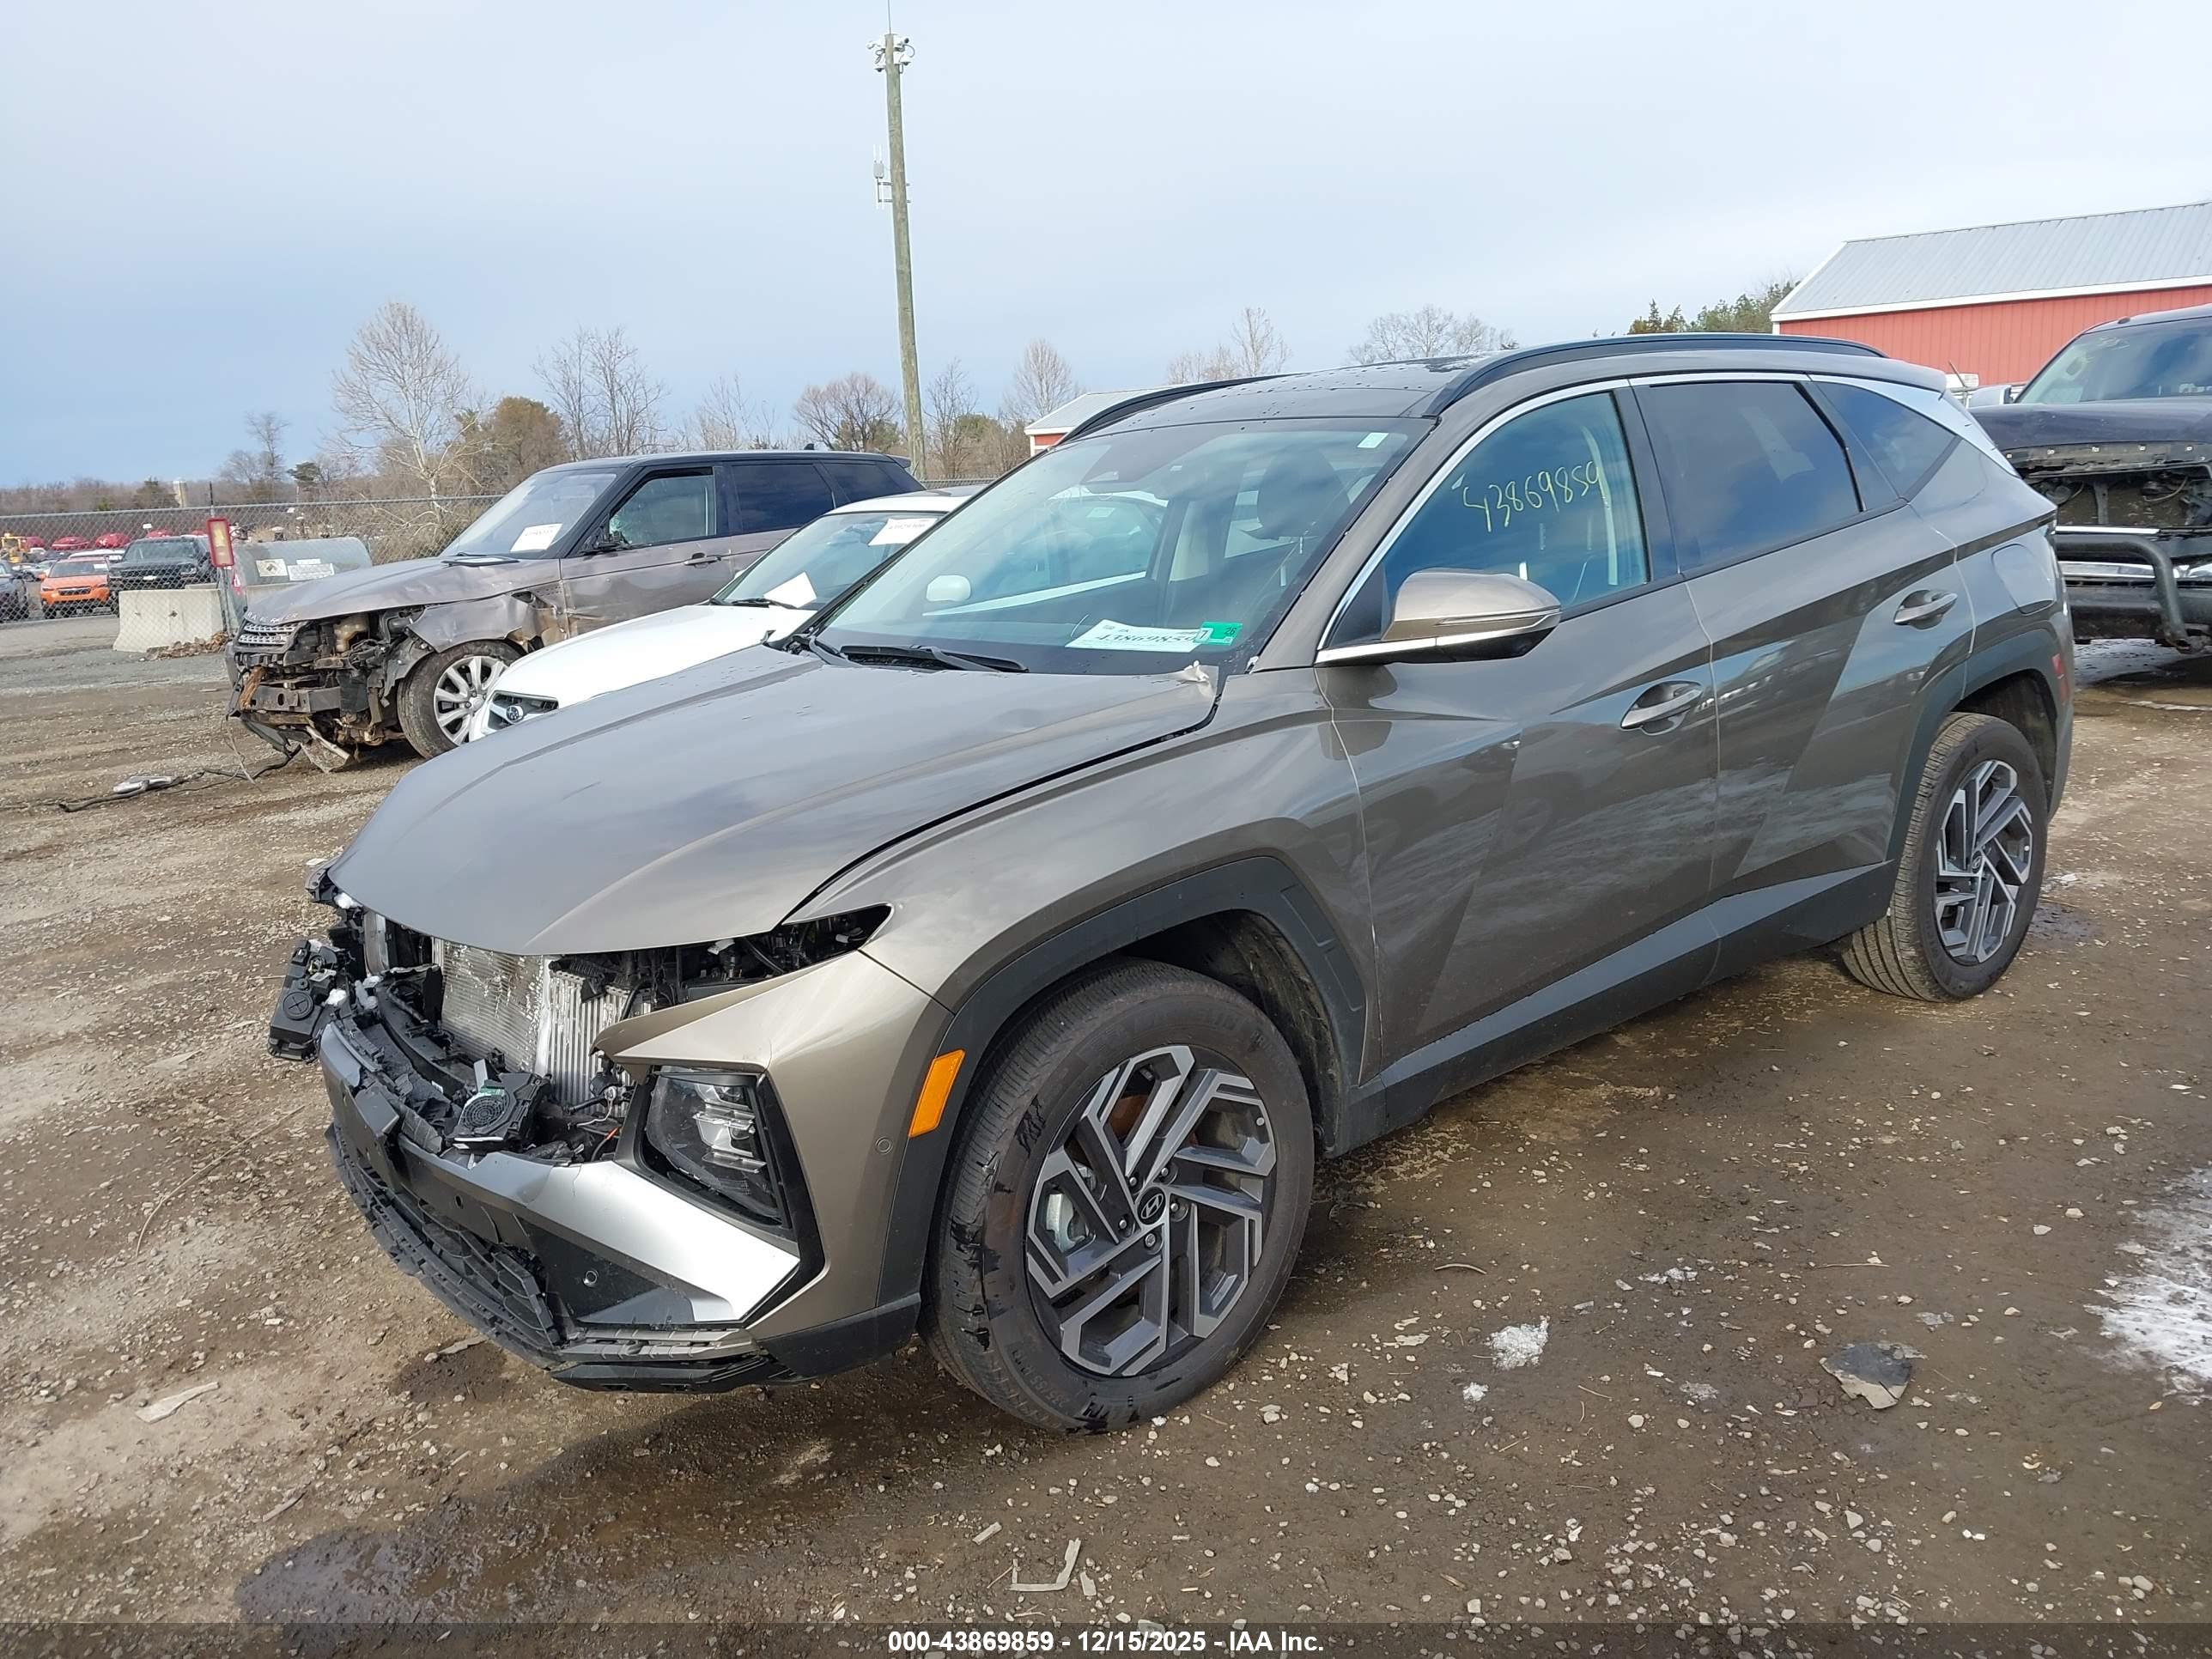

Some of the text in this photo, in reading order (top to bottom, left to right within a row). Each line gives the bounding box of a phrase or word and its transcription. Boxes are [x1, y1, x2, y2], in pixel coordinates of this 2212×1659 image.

[1462, 460, 1604, 532] 43869859
[1200, 626, 1237, 641] 7 26
